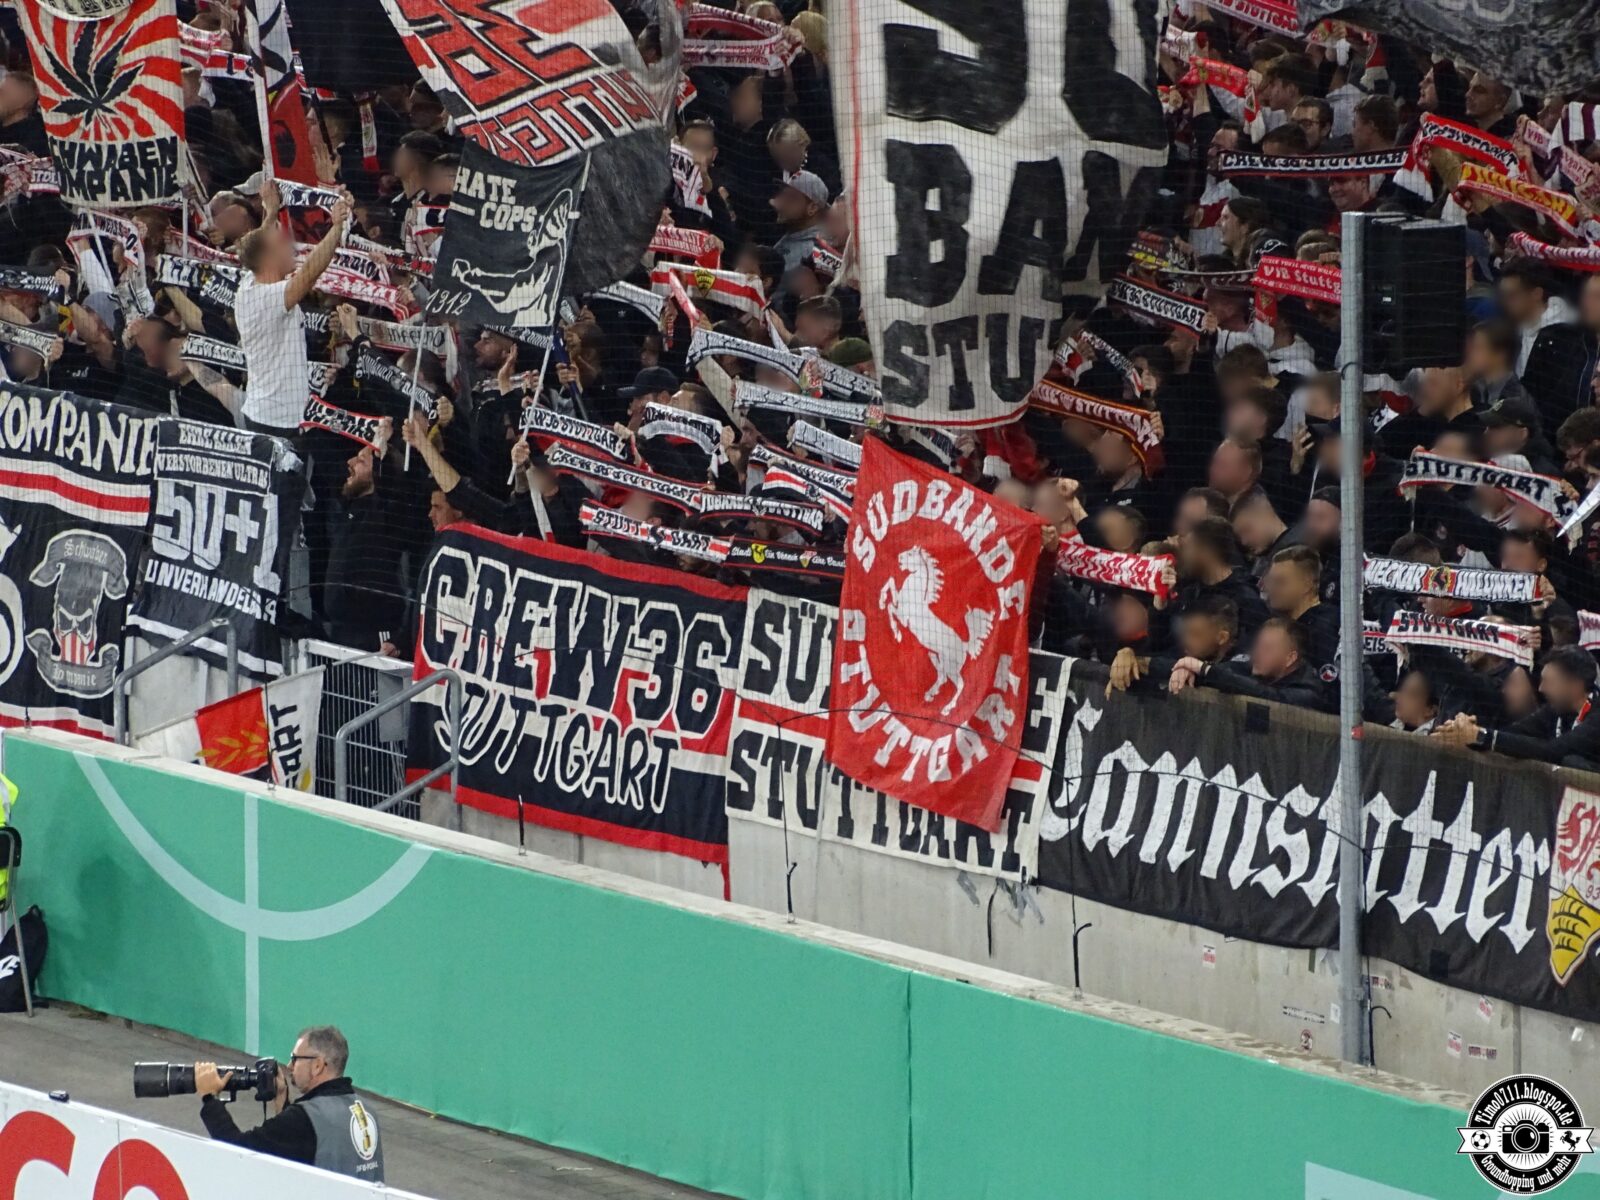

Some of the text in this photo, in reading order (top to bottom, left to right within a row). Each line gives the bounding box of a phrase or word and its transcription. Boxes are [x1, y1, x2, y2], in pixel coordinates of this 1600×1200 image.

[456, 166, 517, 206] HATE
[479, 203, 537, 233] COPS
[425, 288, 472, 317] 1312
[1405, 455, 1550, 501] STUTTGART
[150, 480, 282, 596] 50+1
[853, 478, 1025, 621] SÜDBANDE
[421, 545, 733, 739] CREW 36
